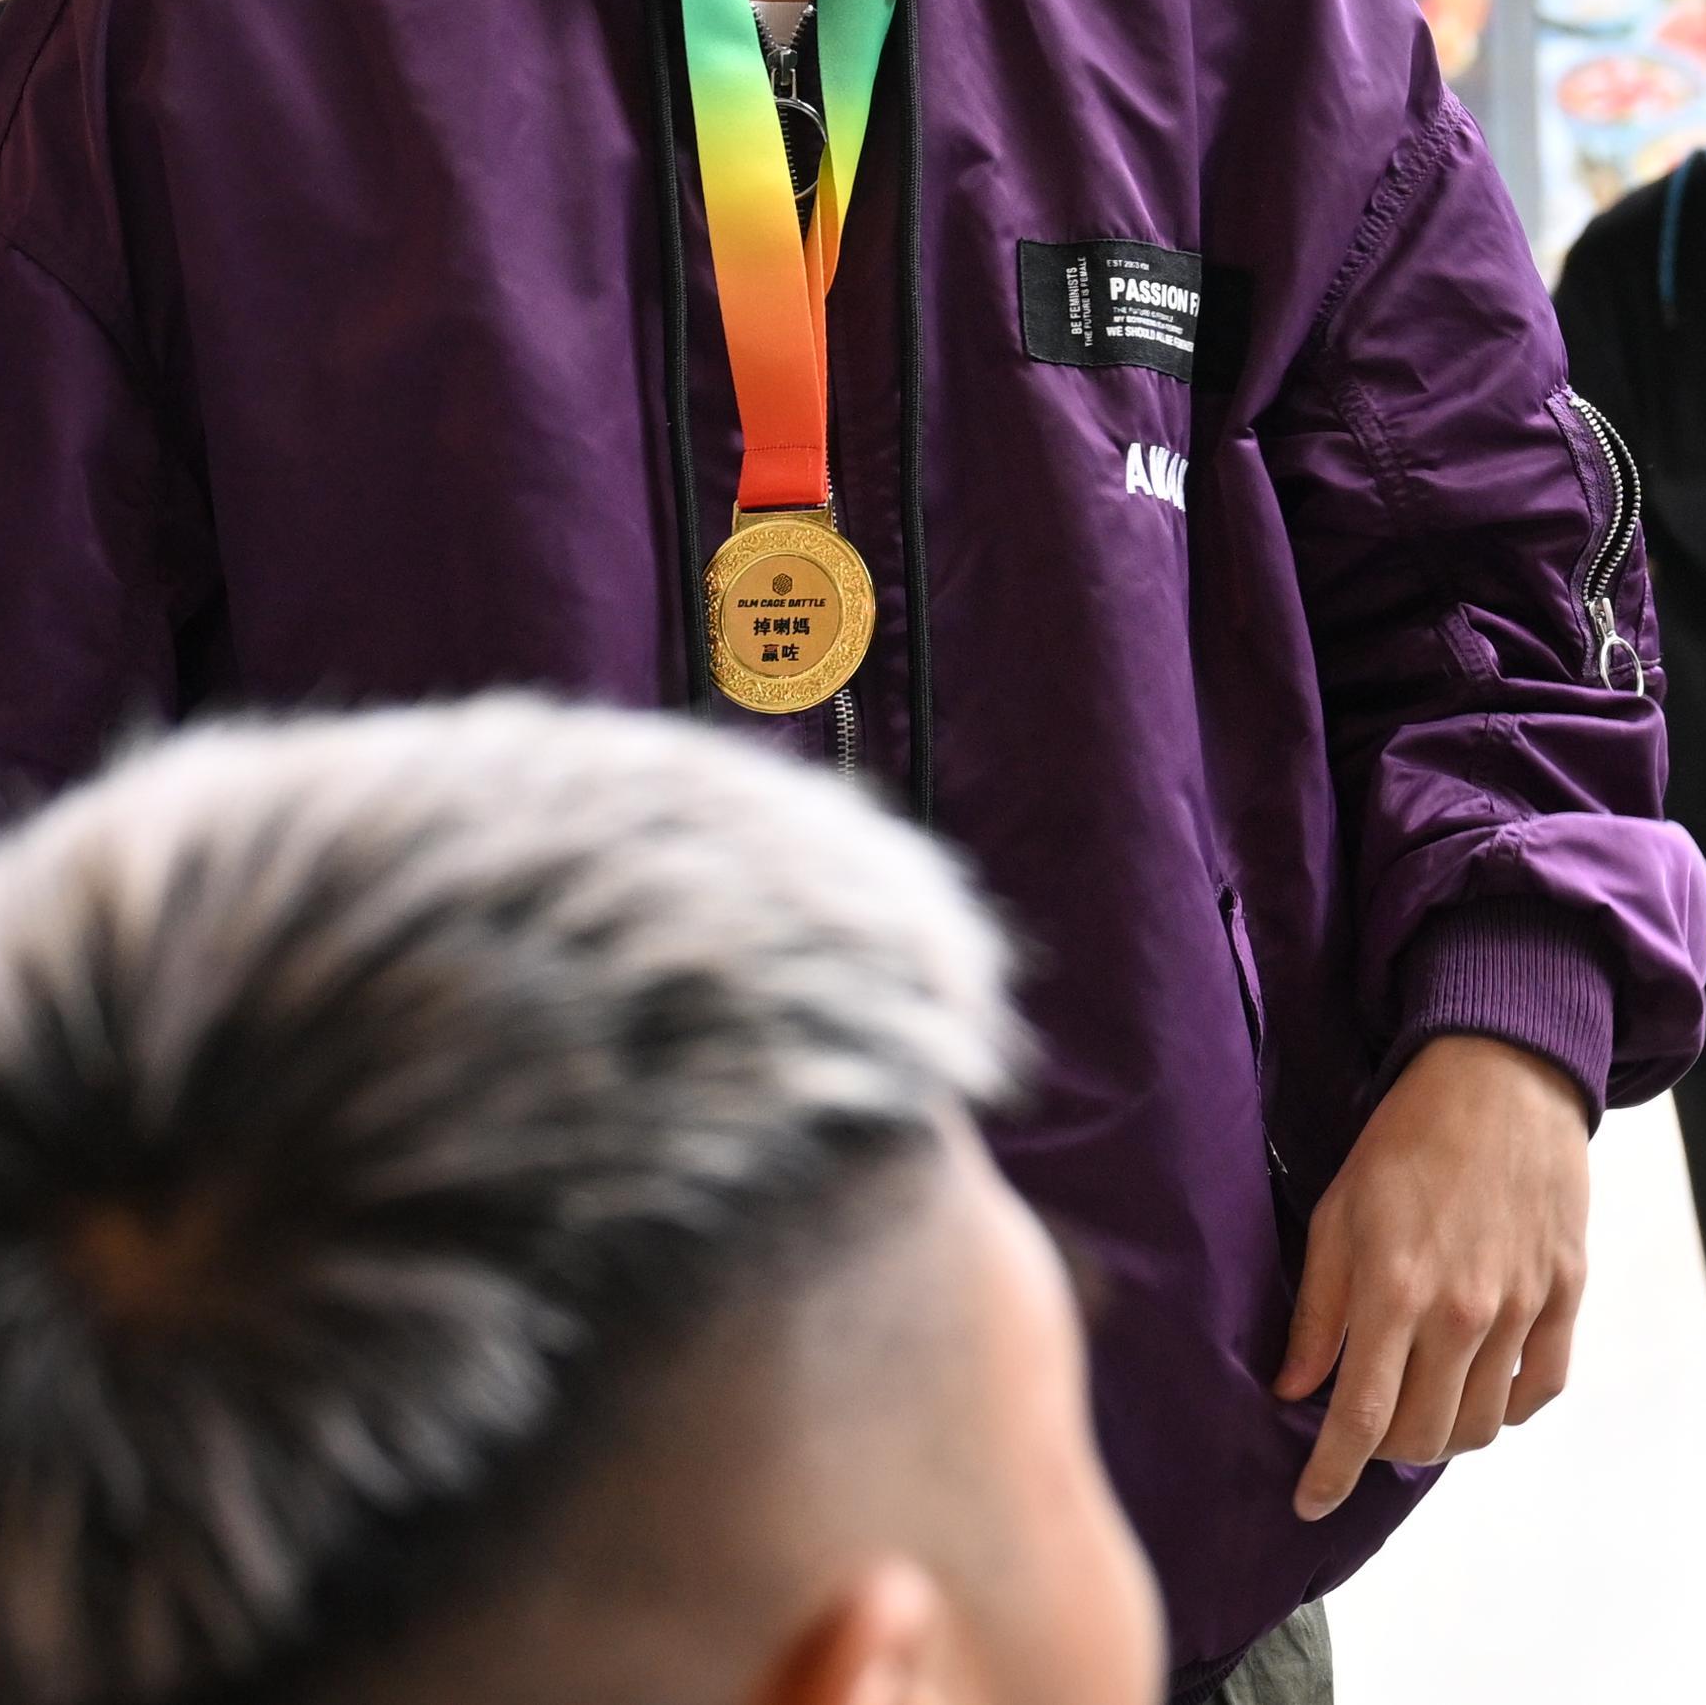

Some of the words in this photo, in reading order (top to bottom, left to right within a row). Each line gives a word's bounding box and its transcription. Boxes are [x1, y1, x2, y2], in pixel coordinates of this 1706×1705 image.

[1066, 266, 1081, 319] FEMINISTS
[1109, 277, 1189, 313] PASSION
[1070, 320, 1083, 335] BE
[1081, 298, 1092, 329] FUTURE
[787, 598, 827, 608] BATTLE
